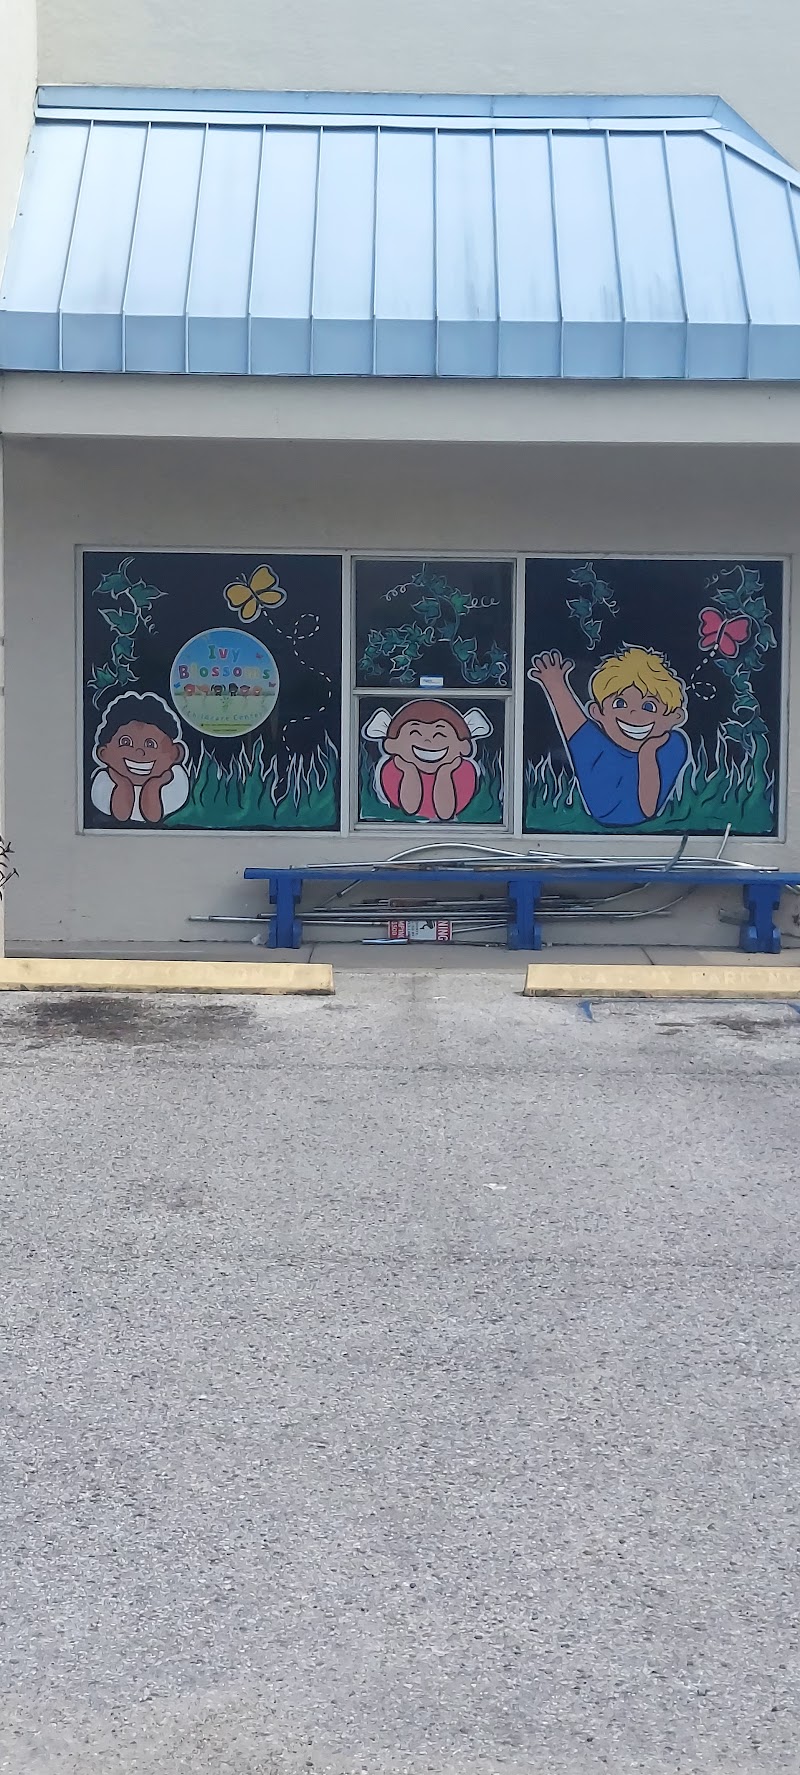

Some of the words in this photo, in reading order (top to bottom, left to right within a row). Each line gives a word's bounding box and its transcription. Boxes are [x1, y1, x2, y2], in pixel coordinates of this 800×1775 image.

[208, 644, 241, 662] Ivy
[178, 663, 271, 680] Blossoms
[187, 710, 229, 721] Childcare
[233, 711, 263, 721] Center
[691, 971, 800, 986] PARKNG
